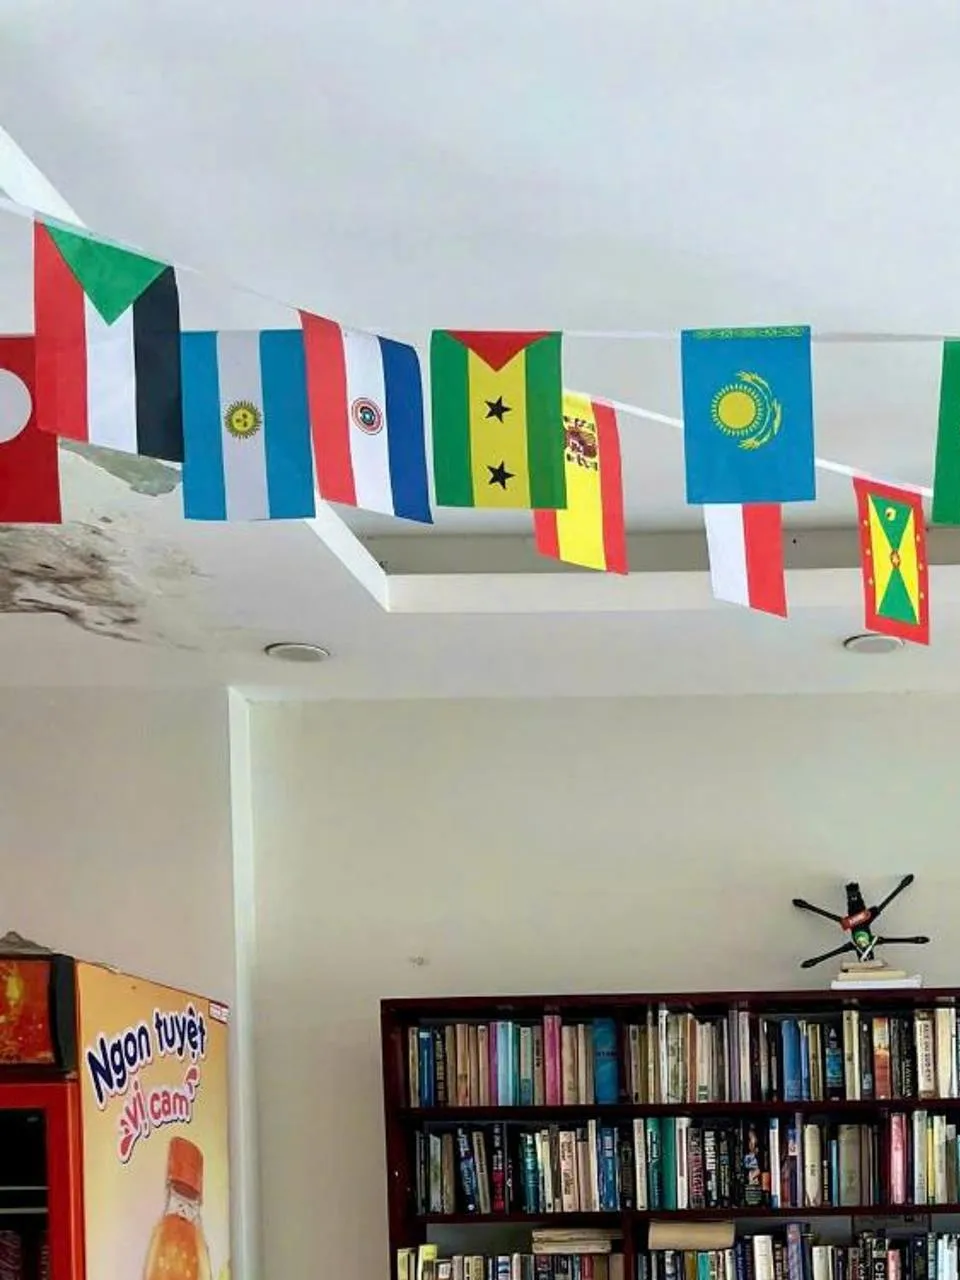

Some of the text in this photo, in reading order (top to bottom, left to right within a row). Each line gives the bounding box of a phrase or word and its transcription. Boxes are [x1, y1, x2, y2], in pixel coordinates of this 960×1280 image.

[87, 1005, 207, 1103] Ngon tuyệt
[149, 1088, 190, 1121] cam
